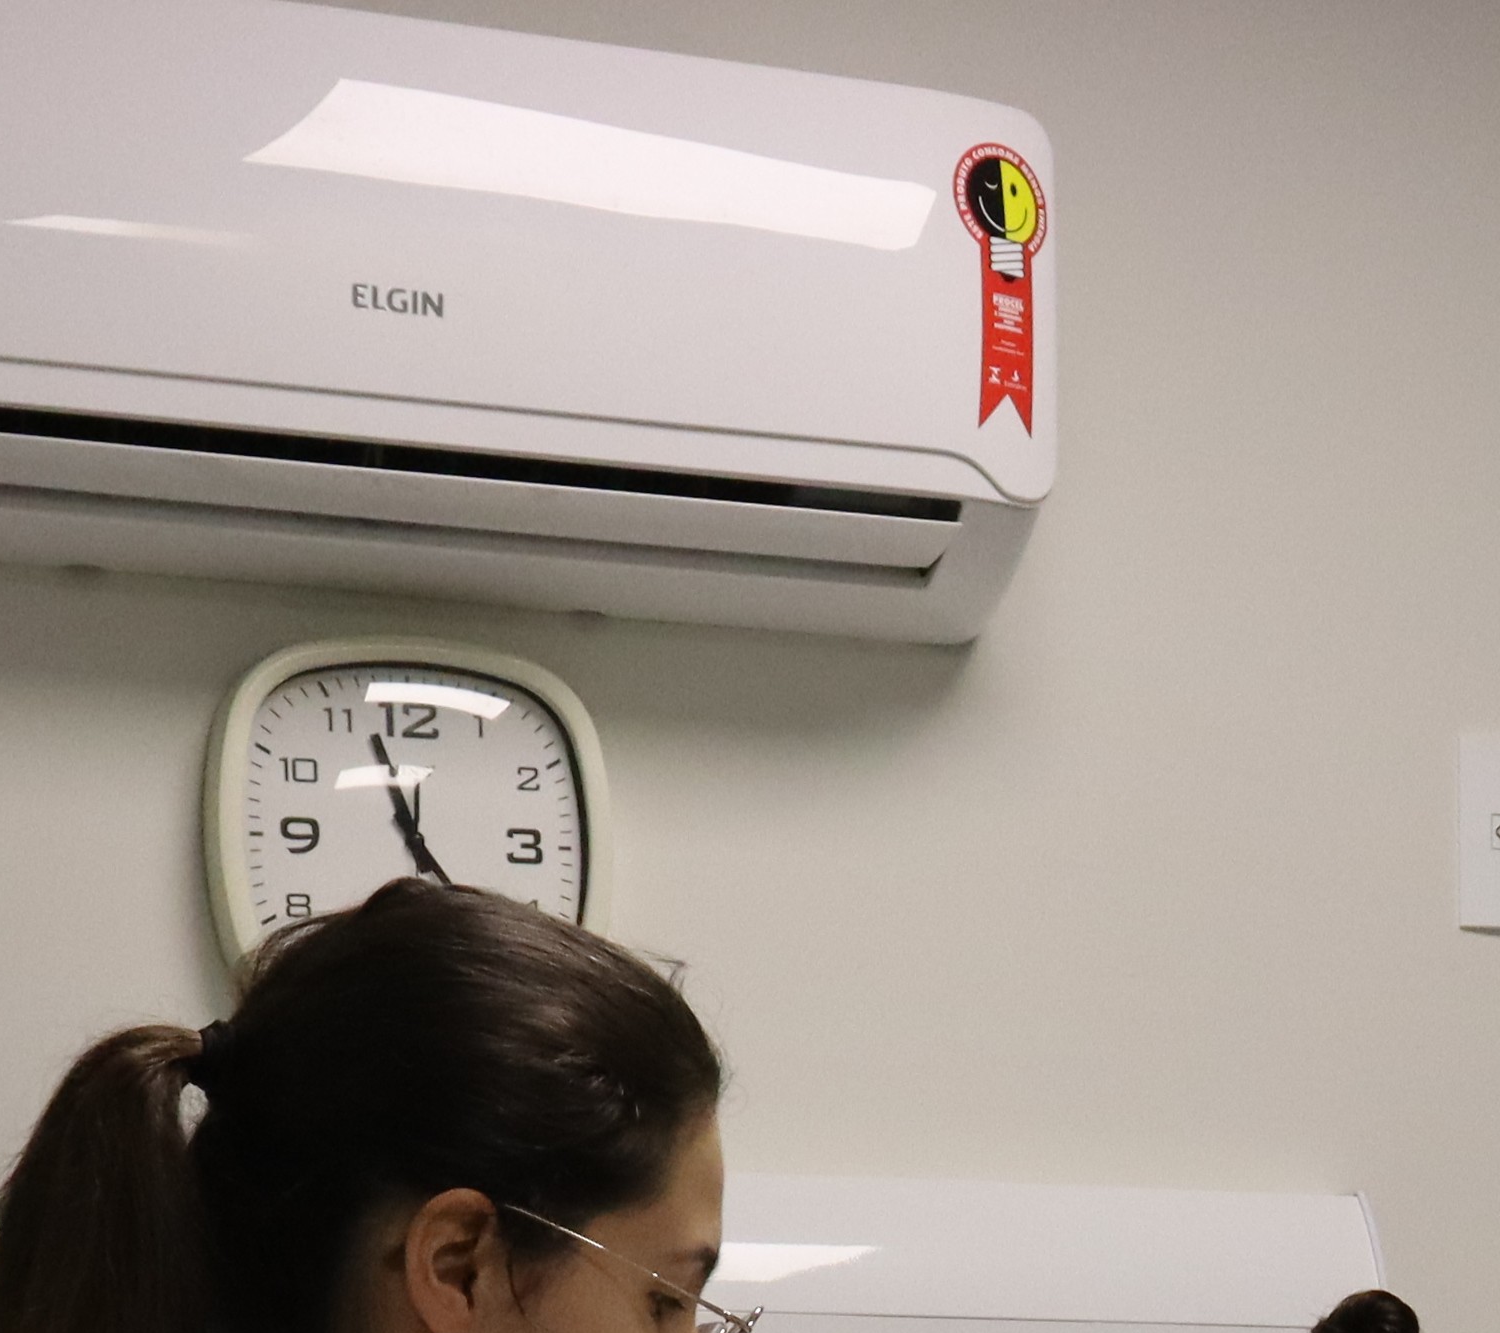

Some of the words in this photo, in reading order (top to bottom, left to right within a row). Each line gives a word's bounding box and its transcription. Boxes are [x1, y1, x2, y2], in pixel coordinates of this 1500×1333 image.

[352, 283, 444, 318] ELGIN
[324, 707, 354, 733] 11
[378, 702, 440, 740] 12
[279, 757, 318, 783] 10
[517, 767, 540, 792] 2
[280, 817, 320, 854] 9
[506, 828, 543, 865] 3
[286, 893, 311, 918] 8
